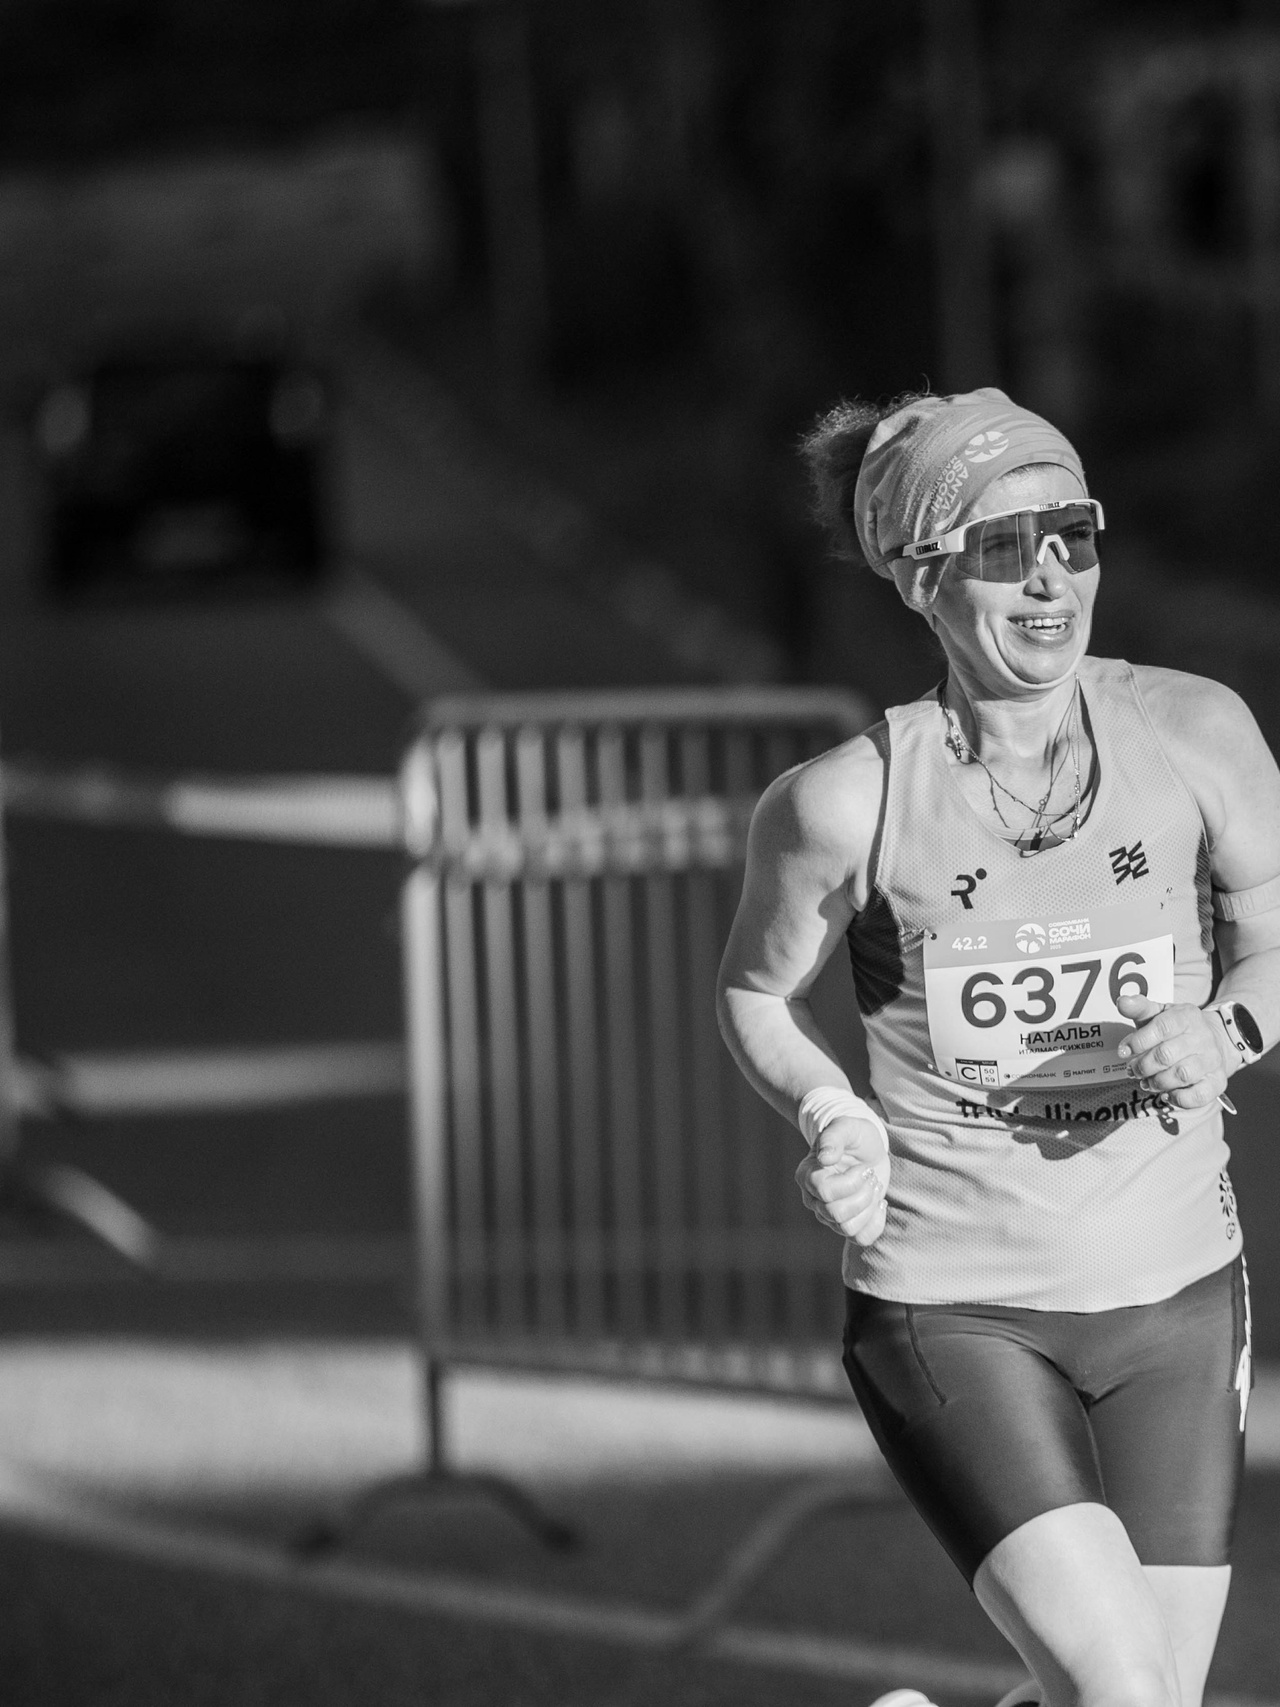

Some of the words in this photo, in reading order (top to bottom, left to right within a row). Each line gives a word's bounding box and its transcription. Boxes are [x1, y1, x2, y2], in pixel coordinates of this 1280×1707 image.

[941, 466, 969, 511] ANTA
[1048, 923, 1091, 939] СОЧИ
[1049, 933, 1092, 945] МАРАФОН
[952, 936, 988, 951] 42.2
[961, 952, 1149, 1028] 6376
[1020, 1024, 1102, 1045] НАТАЛЬЯ
[1072, 1068, 1096, 1076] МАГНИТ
